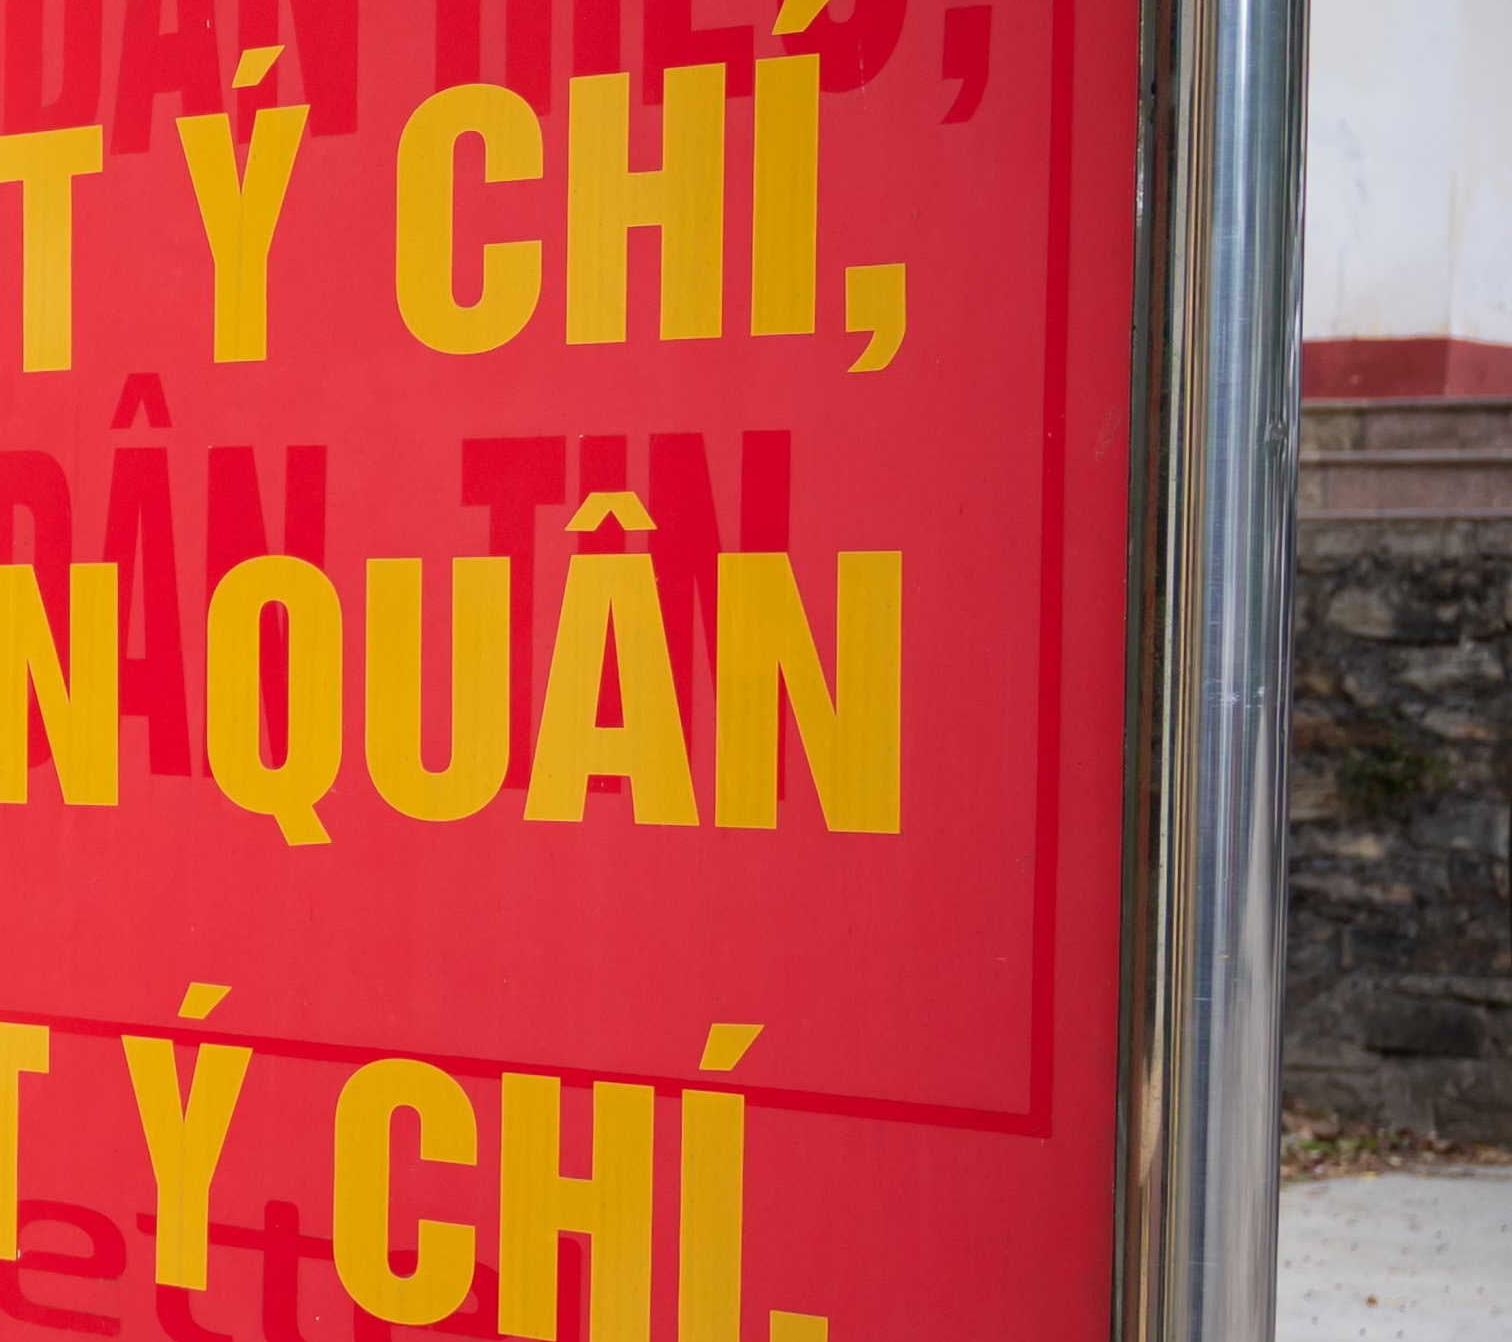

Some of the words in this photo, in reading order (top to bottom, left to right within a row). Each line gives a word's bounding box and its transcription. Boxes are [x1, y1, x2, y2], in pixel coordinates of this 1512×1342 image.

[178, 47, 307, 361] Ý
[209, 494, 901, 844] QUÂN
[124, 985, 250, 1289] Ý
